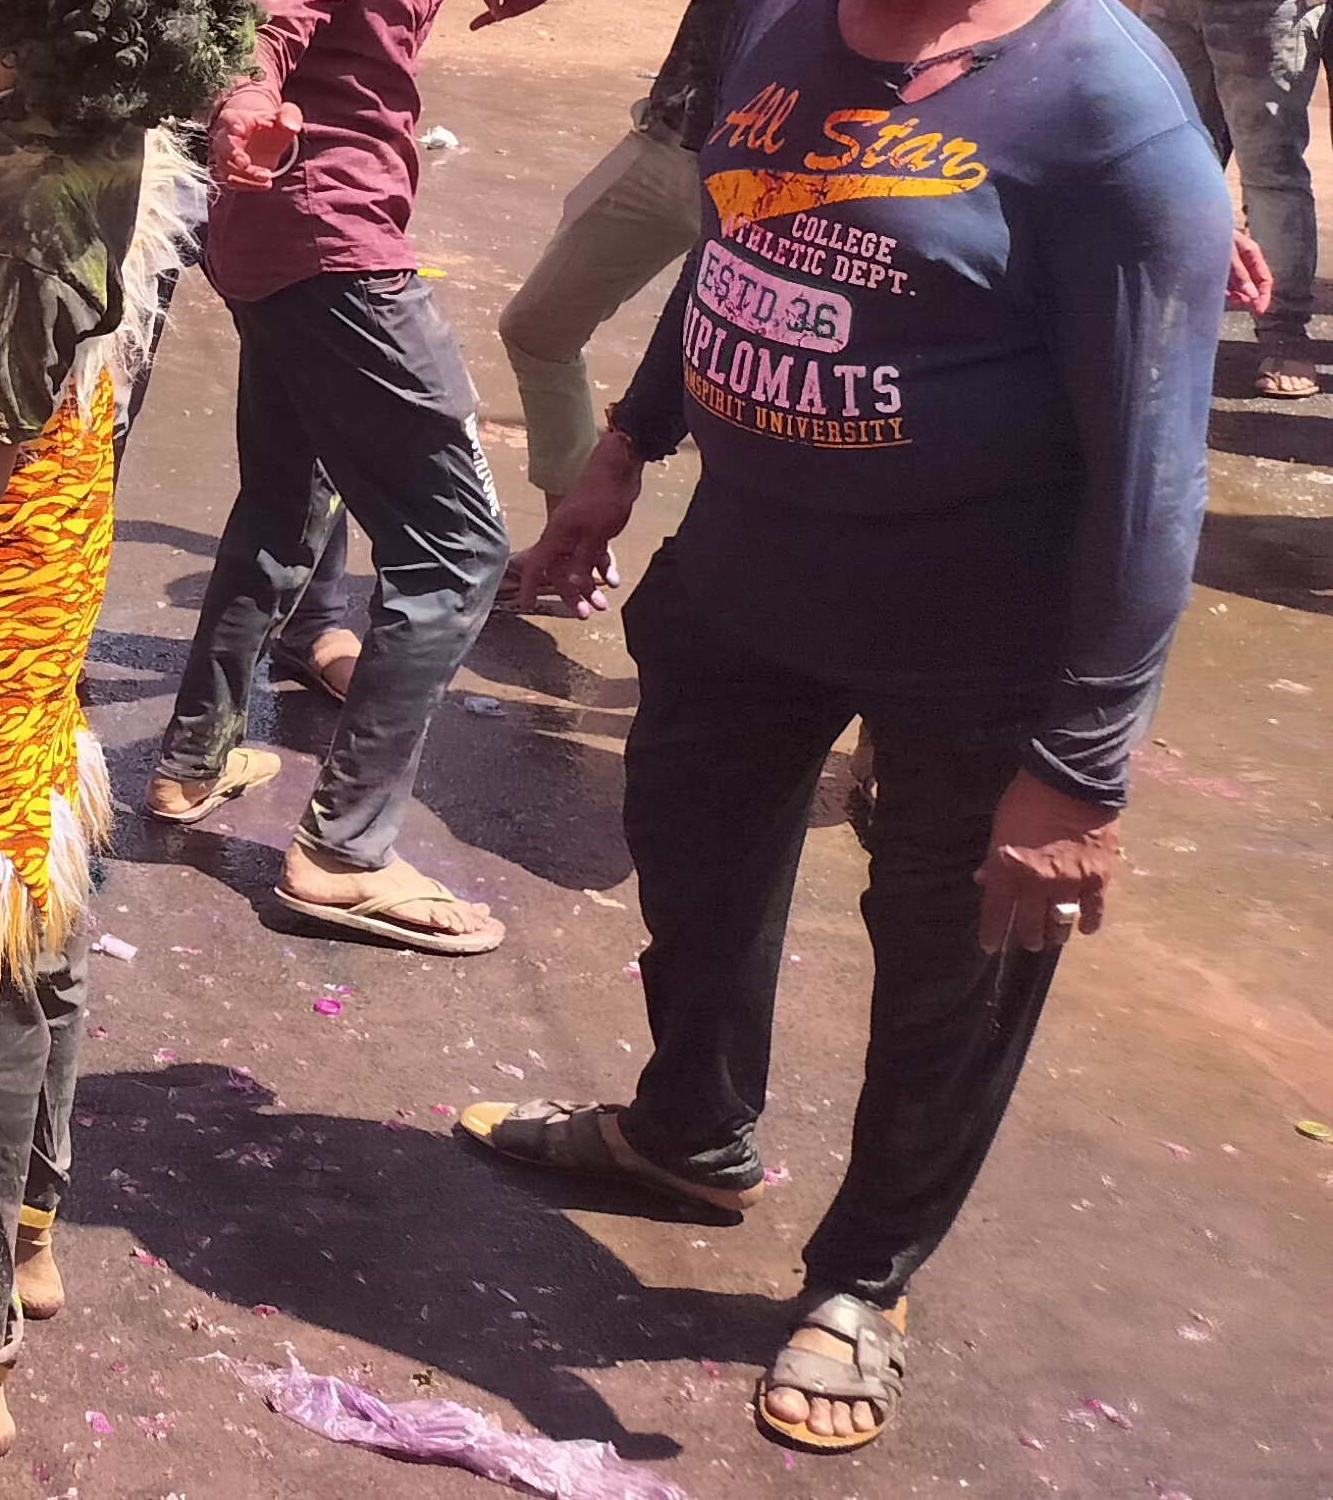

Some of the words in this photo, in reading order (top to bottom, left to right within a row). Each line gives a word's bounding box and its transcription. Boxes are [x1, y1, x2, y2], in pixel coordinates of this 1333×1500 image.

[709, 82, 799, 154] All
[804, 108, 988, 180] Star
[721, 213, 827, 276] ATHLETIC
[792, 213, 897, 264] COLLEGE
[755, 406, 904, 443] UNIVERSITY
